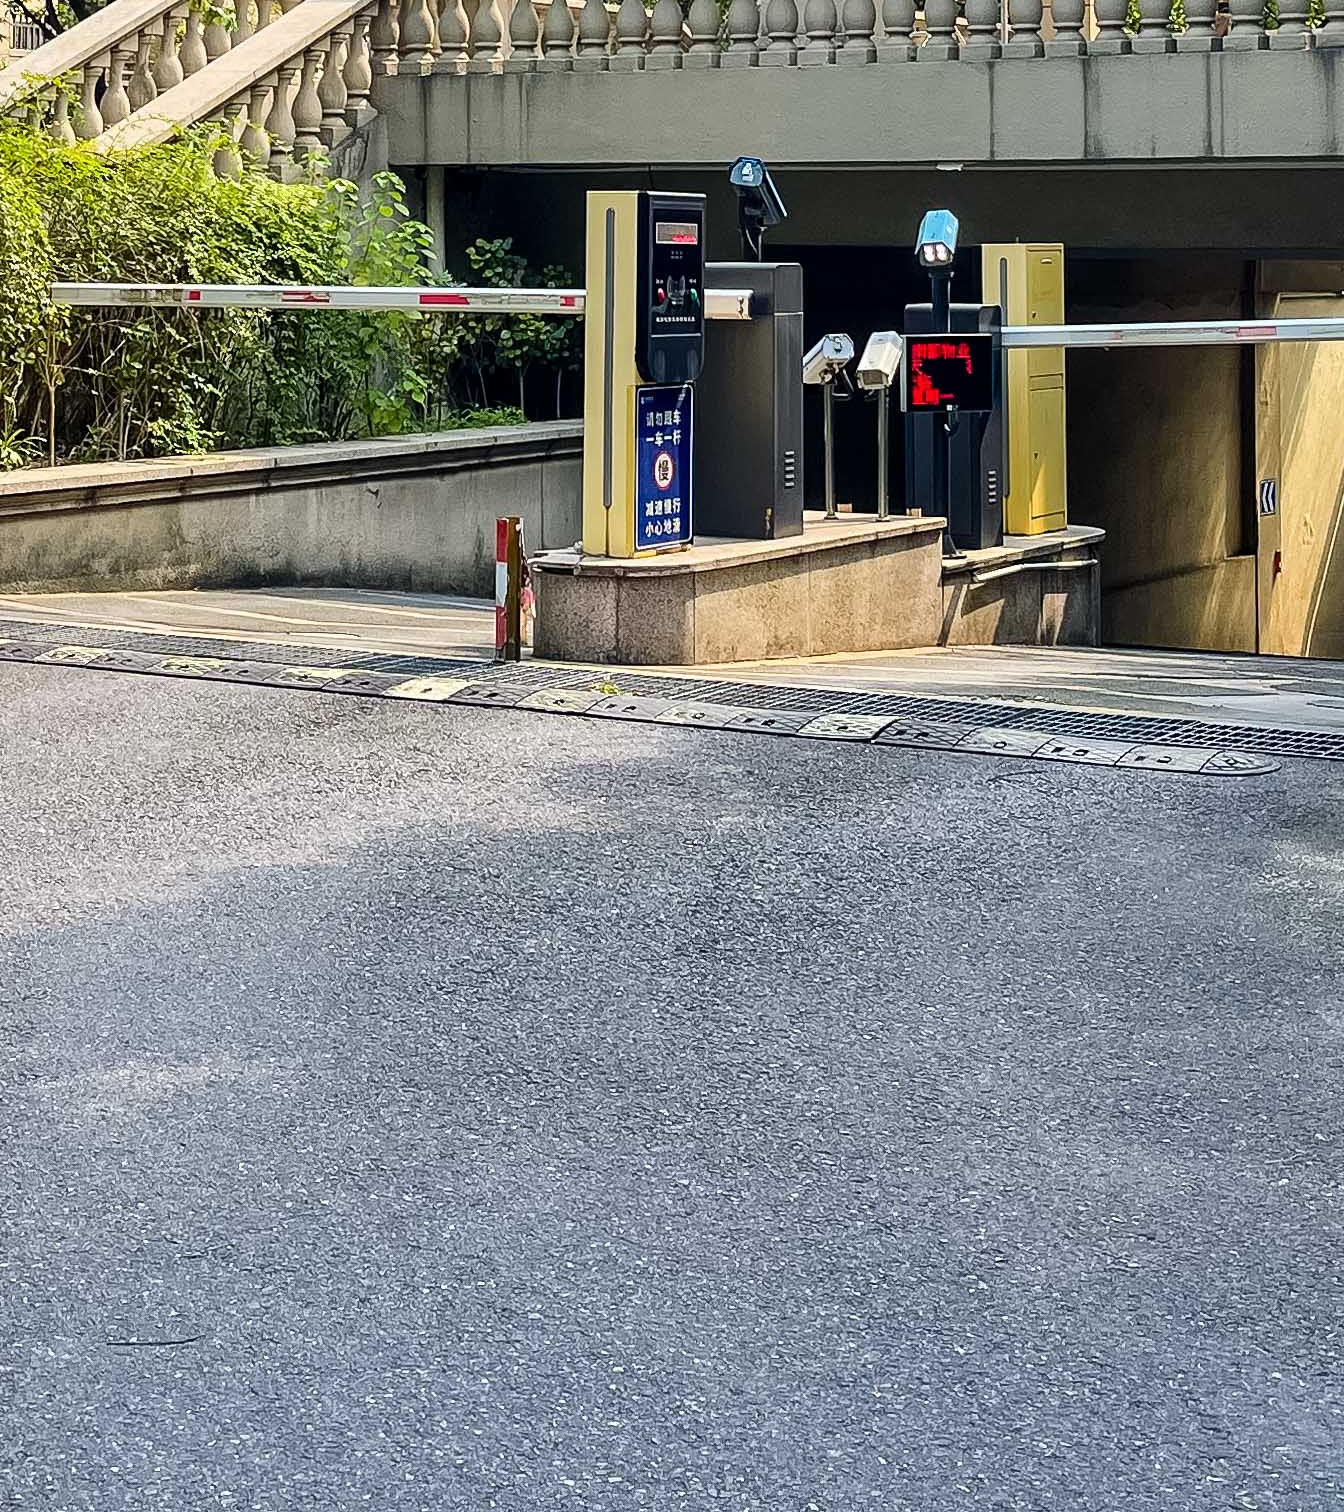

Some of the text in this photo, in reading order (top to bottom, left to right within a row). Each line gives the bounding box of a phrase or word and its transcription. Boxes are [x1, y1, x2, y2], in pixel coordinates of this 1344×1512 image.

[645, 429, 681, 447] 一车一杆
[658, 459, 669, 481] 慢
[645, 497, 681, 517] 减速慢行
[645, 517, 681, 538] 小心地滑
